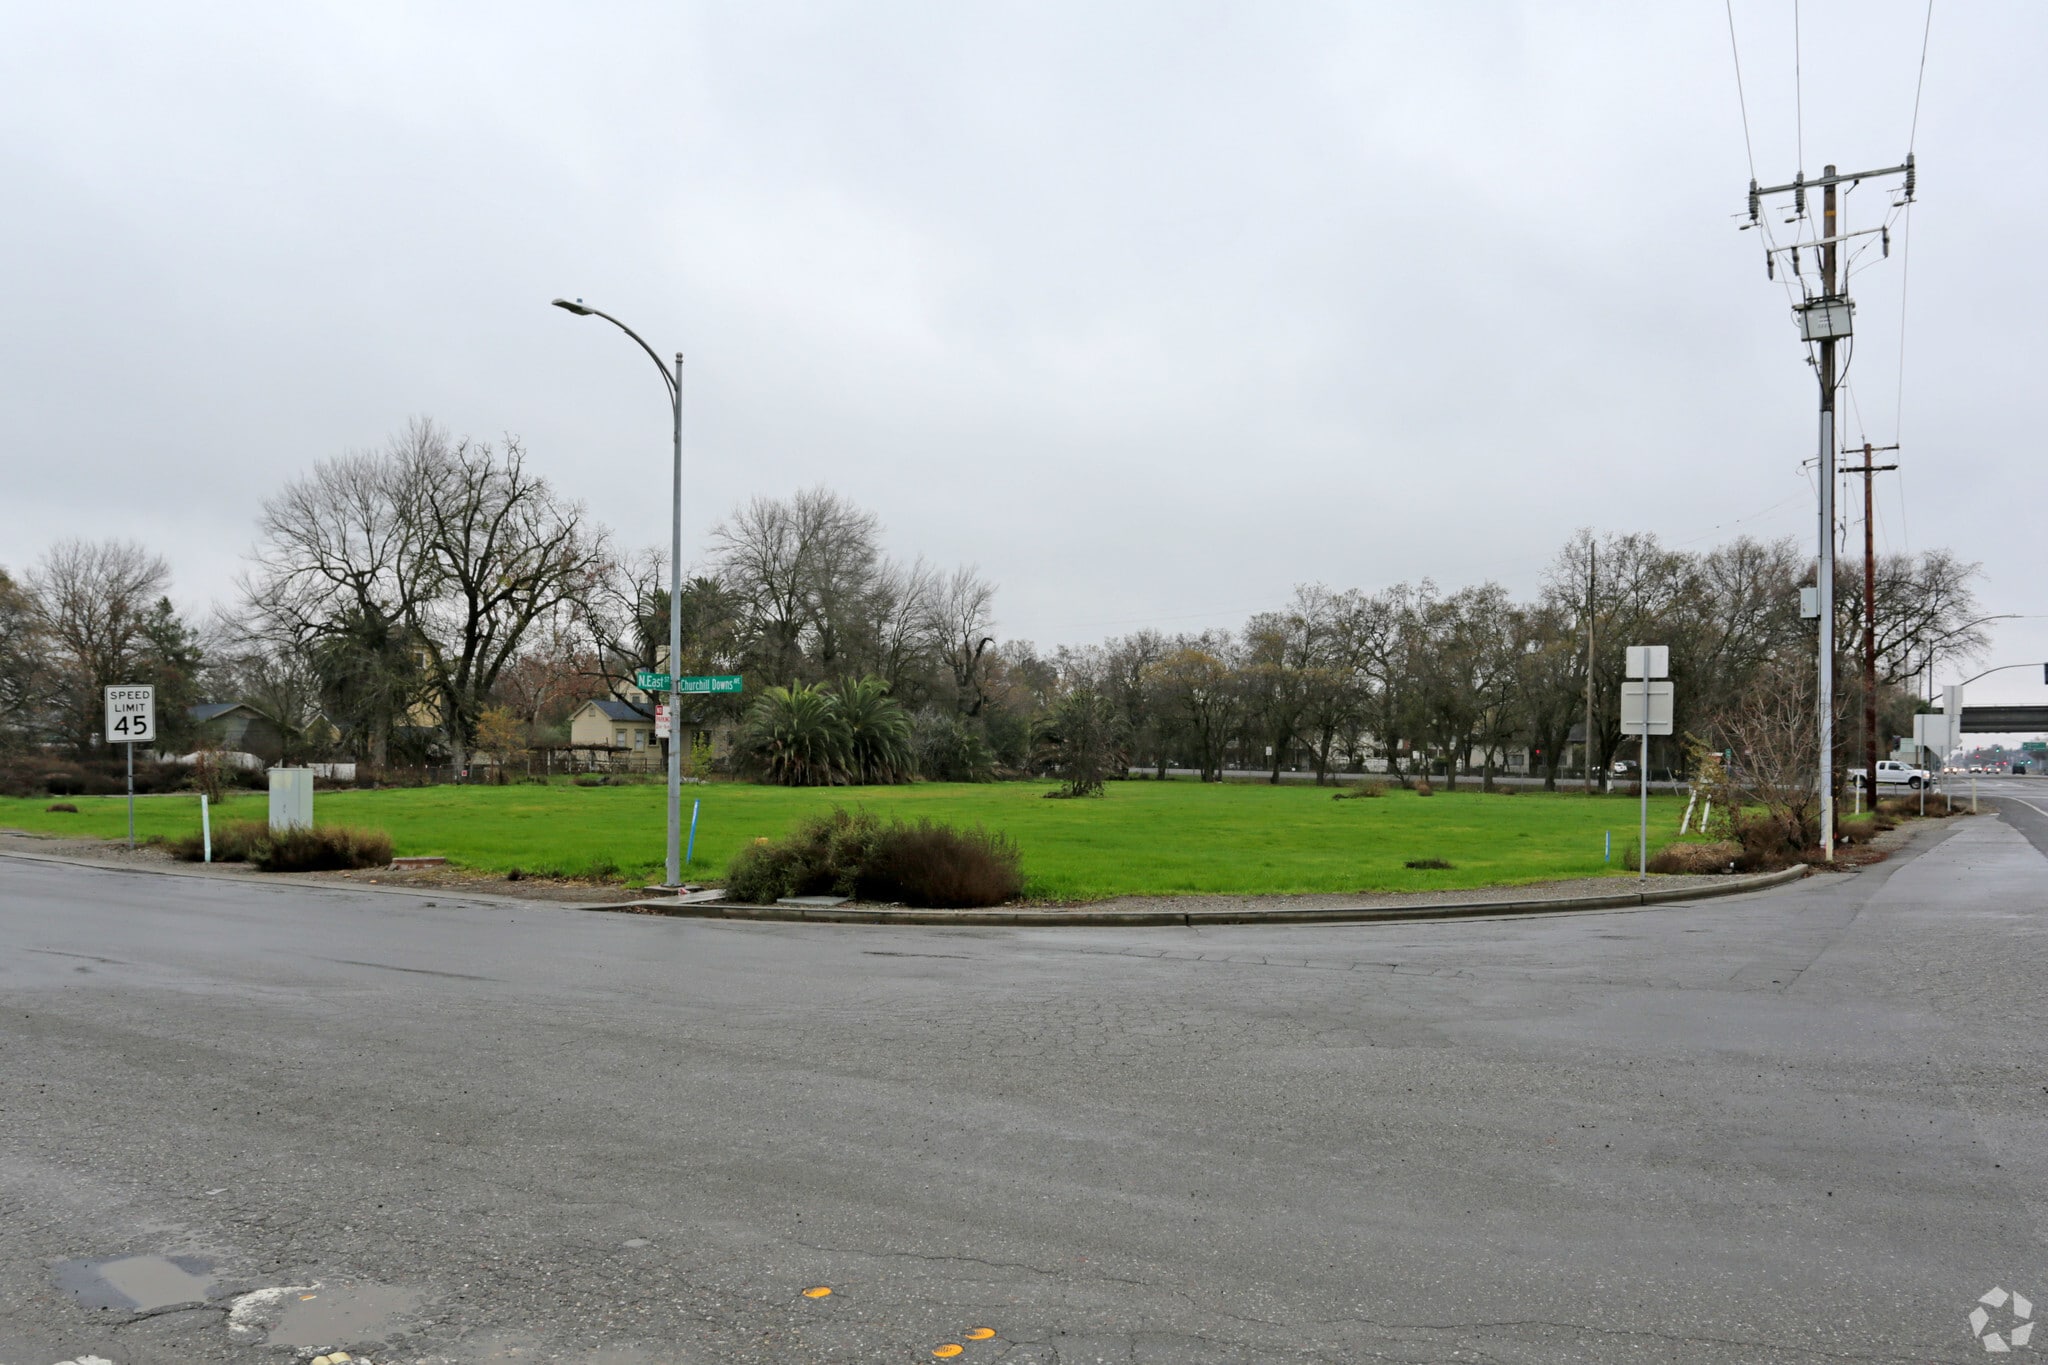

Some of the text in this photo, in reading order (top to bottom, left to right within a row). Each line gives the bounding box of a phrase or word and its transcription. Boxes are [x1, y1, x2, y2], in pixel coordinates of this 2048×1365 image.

[681, 679, 710, 691] Churchill
[712, 678, 733, 690] Downs
[110, 691, 150, 700] SPEED
[114, 703, 145, 713] LIMIT
[114, 715, 147, 735] 45
